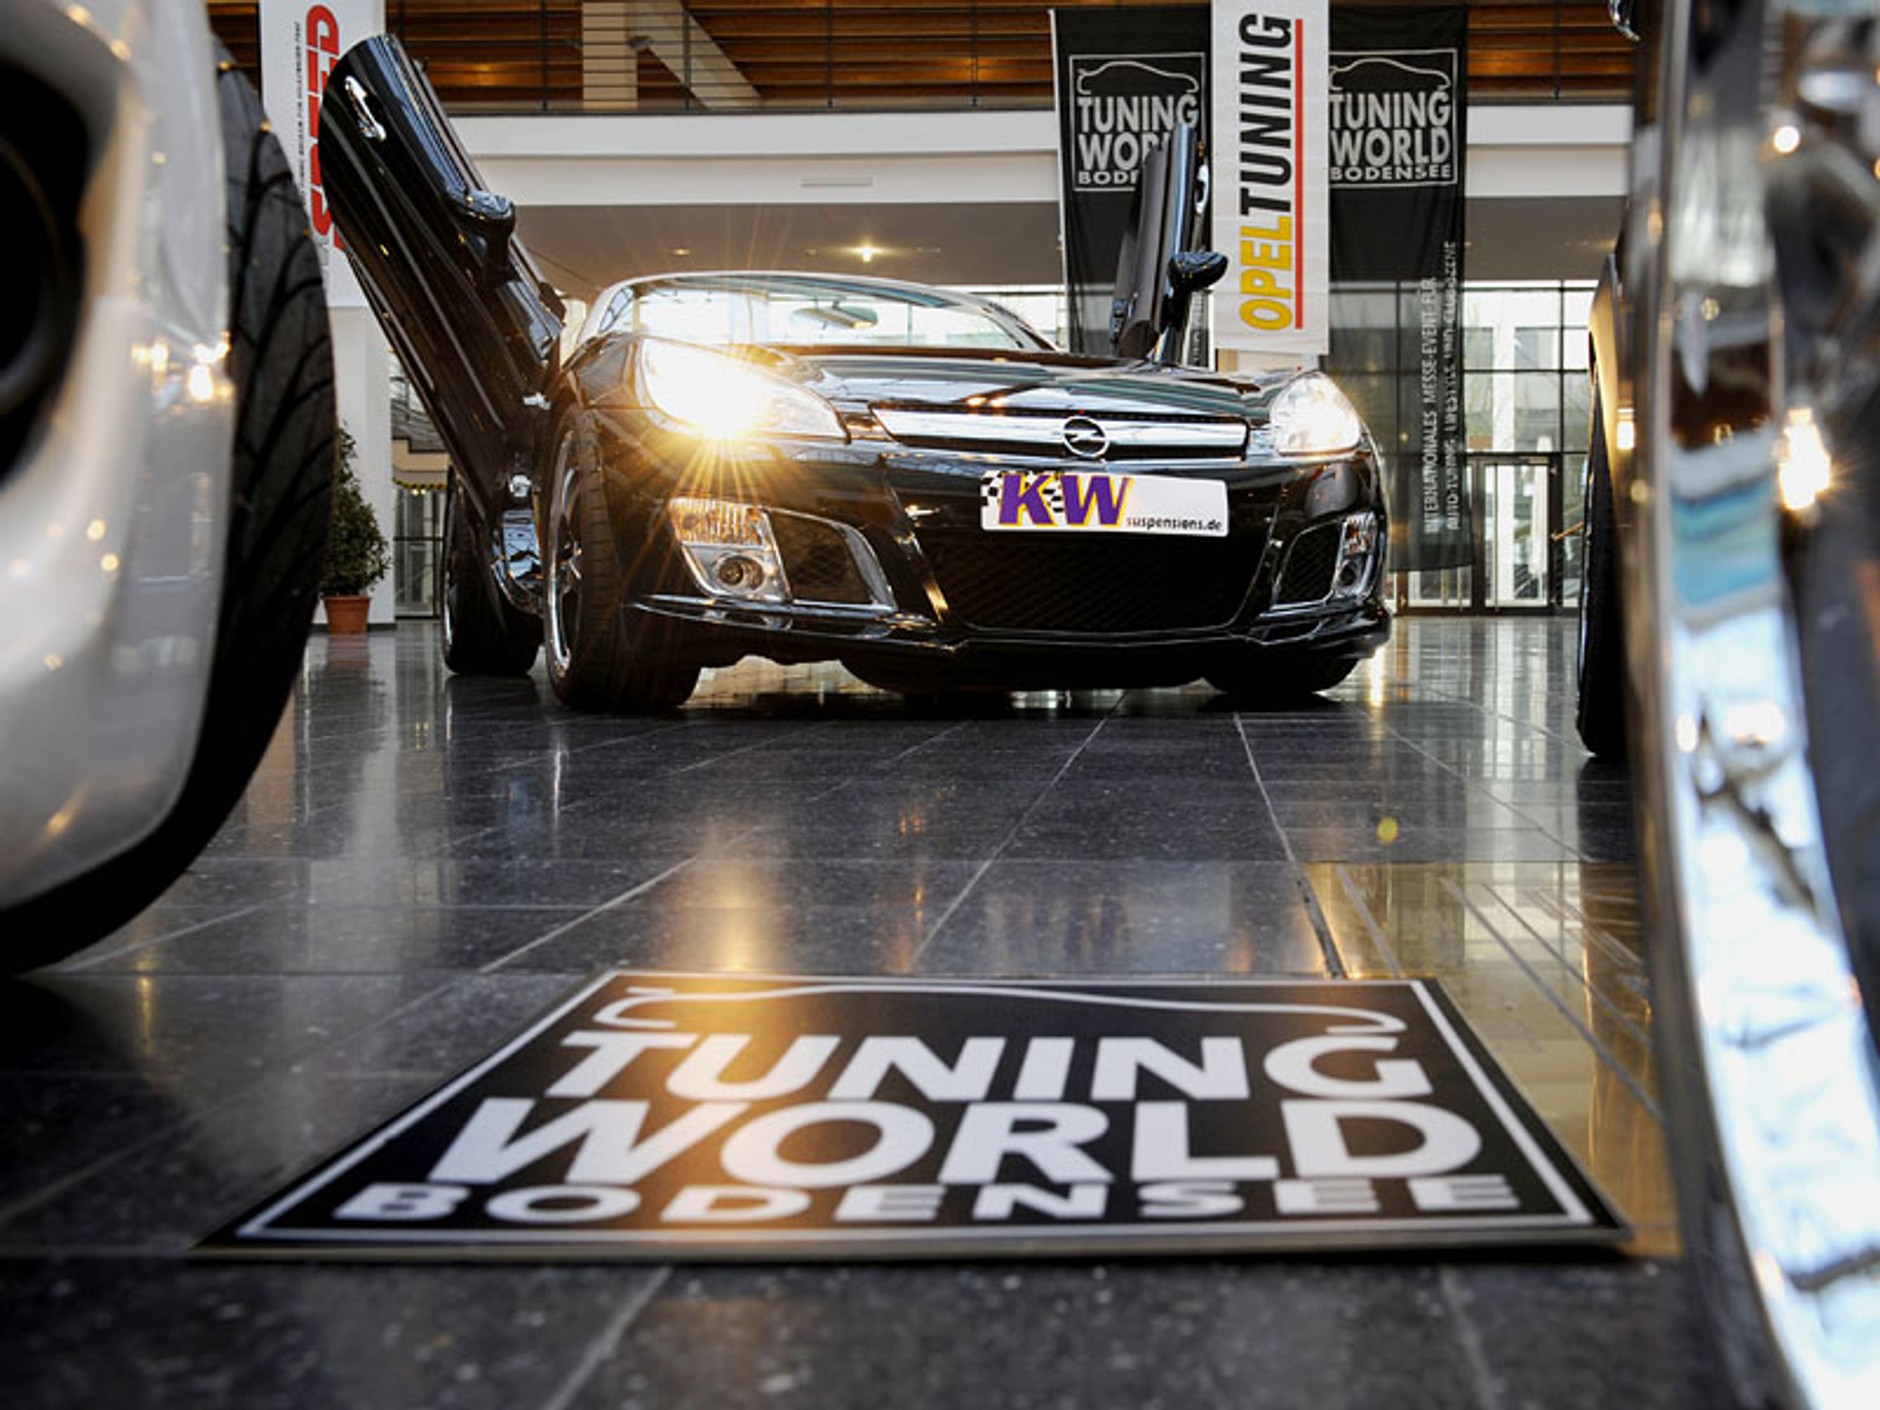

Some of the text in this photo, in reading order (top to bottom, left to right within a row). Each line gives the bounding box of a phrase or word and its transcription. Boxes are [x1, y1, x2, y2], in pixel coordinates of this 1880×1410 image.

[1077, 94, 1199, 133] TUNING
[1329, 91, 1451, 130] TUNING
[1330, 127, 1451, 167] WORLD
[1330, 164, 1451, 181] BODENSEE
[1422, 410, 1440, 533] INTERNATIONALES
[998, 472, 1222, 532] KW suspensions.de
[545, 1031, 1433, 1100] TUNING
[427, 1098, 1482, 1189] WORLD
[332, 1174, 1520, 1224] BODENSEE
